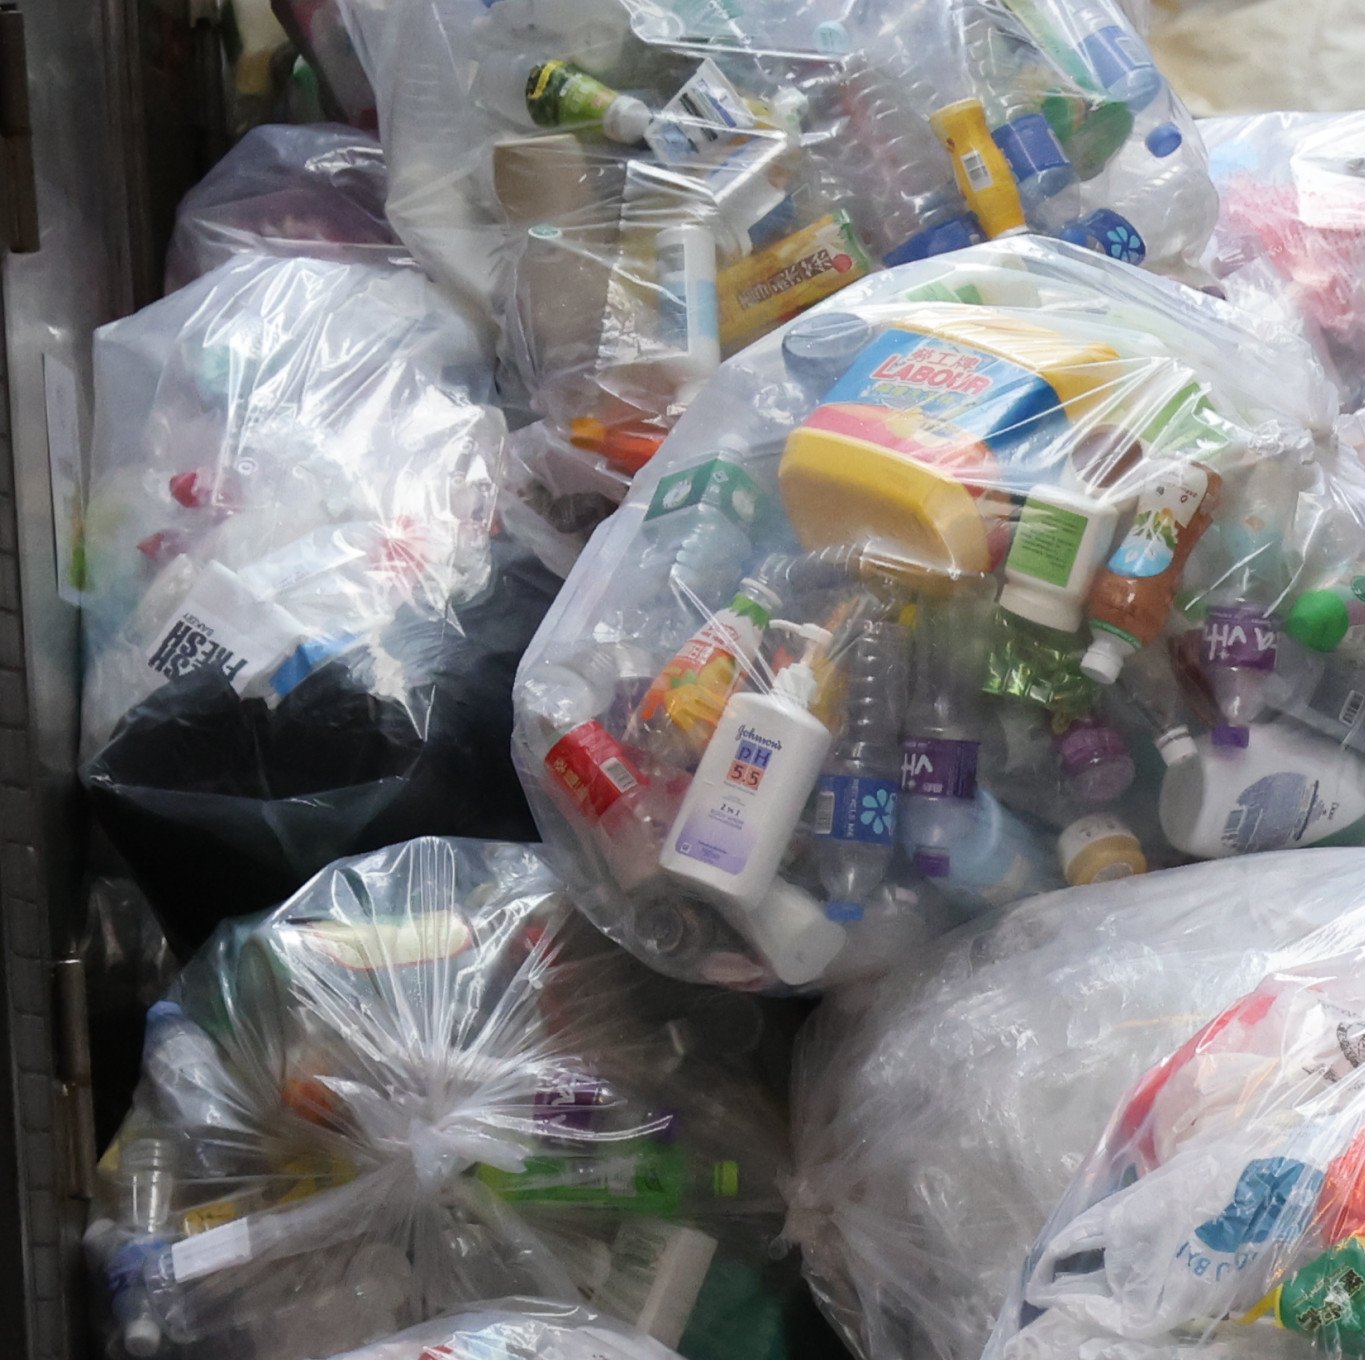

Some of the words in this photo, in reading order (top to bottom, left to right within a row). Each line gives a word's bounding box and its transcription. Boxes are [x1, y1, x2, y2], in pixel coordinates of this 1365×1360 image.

[871, 355, 991, 395] LABOUR
[183, 612, 214, 637] BAKERY
[165, 620, 248, 682] FRESH
[735, 724, 782, 751] Johnson's
[739, 746, 772, 767] pH
[731, 764, 761, 786] 5.5
